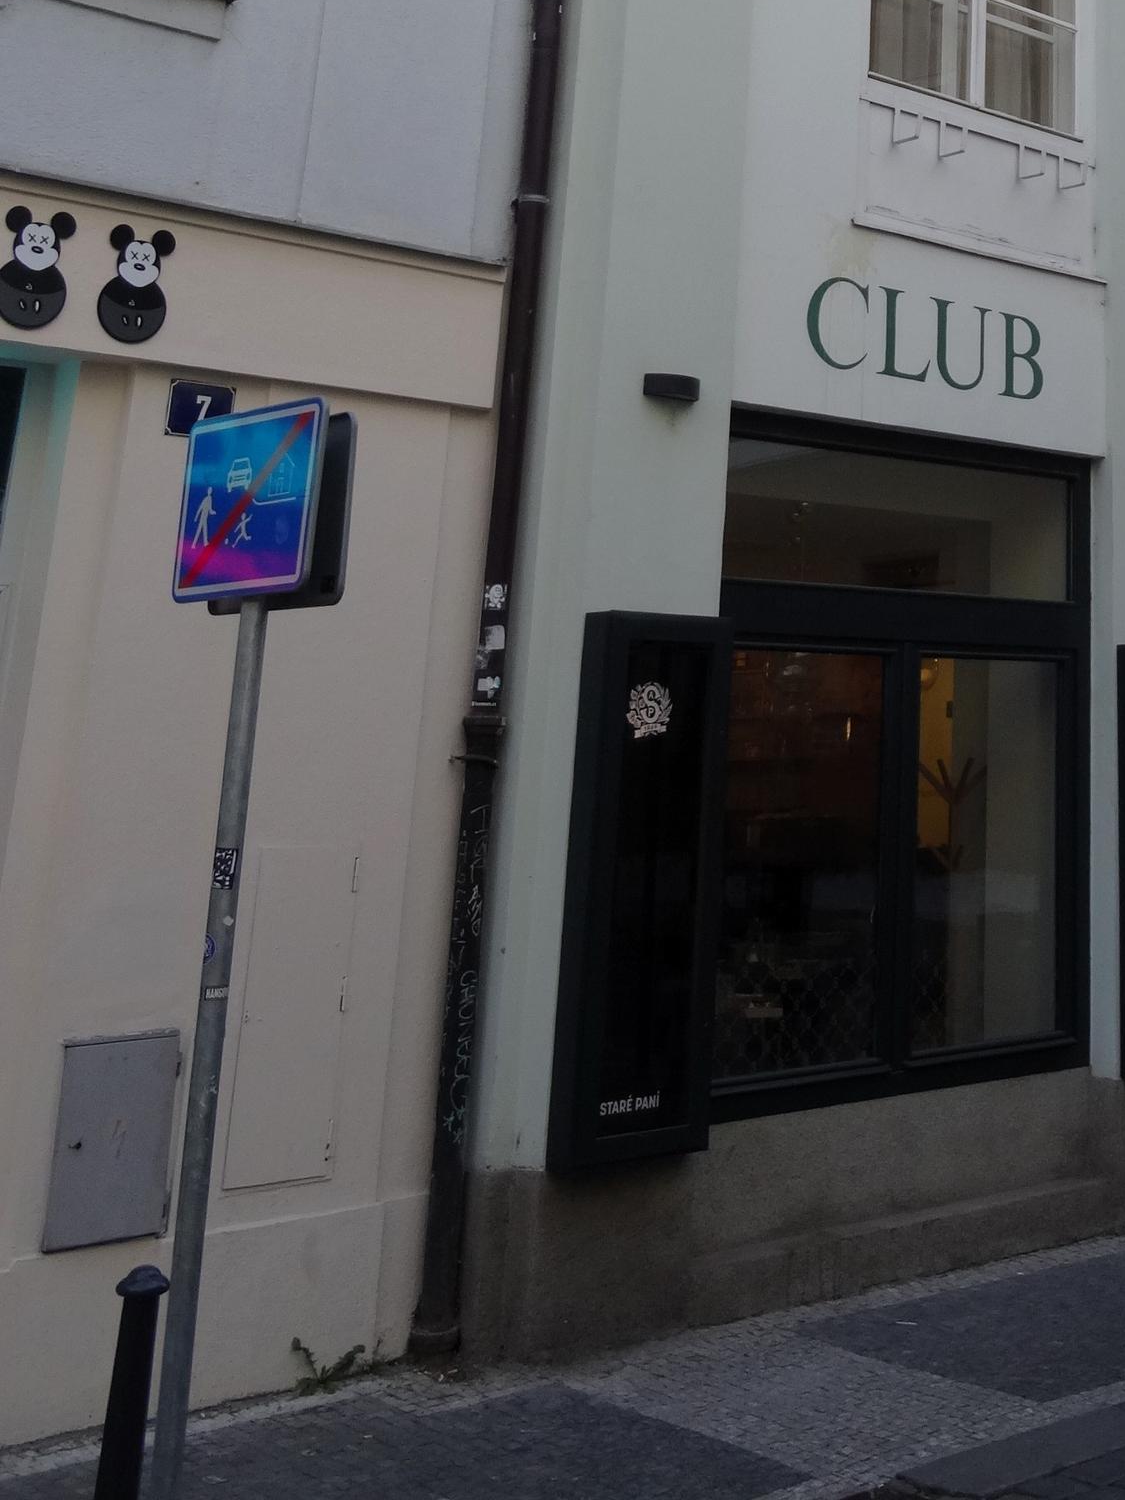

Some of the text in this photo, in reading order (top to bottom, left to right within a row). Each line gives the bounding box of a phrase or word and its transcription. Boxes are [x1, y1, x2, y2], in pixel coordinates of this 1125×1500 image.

[806, 276, 1045, 400] CLUB
[195, 396, 213, 420] 7
[599, 1089, 661, 1116] STARÉ PANÍ
